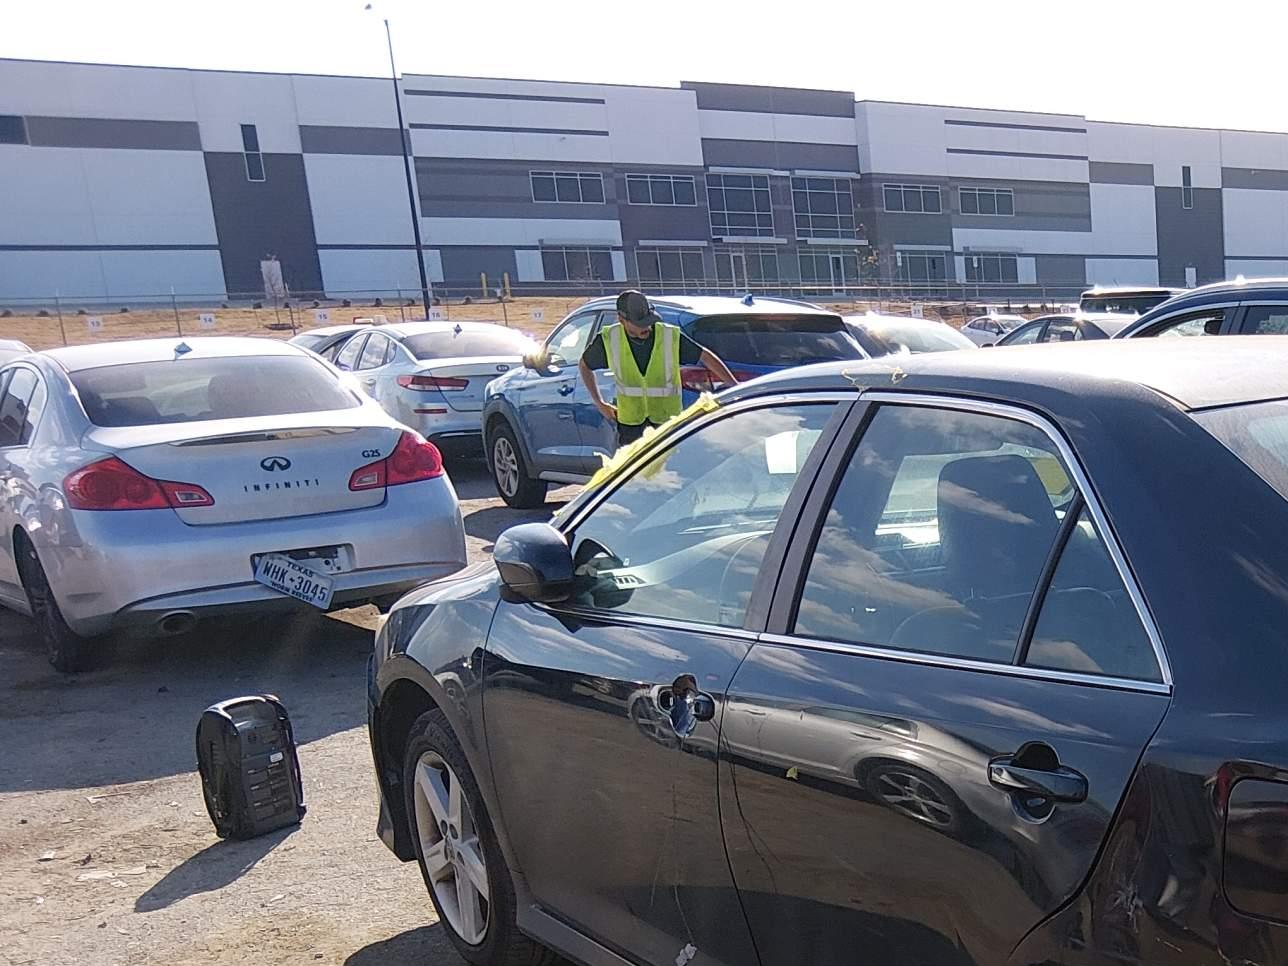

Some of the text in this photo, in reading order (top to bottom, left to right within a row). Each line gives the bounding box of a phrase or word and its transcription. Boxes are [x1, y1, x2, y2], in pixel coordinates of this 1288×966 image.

[361, 449, 381, 458] G25
[244, 479, 319, 492] INFINITI
[287, 561, 314, 577] TEXAS
